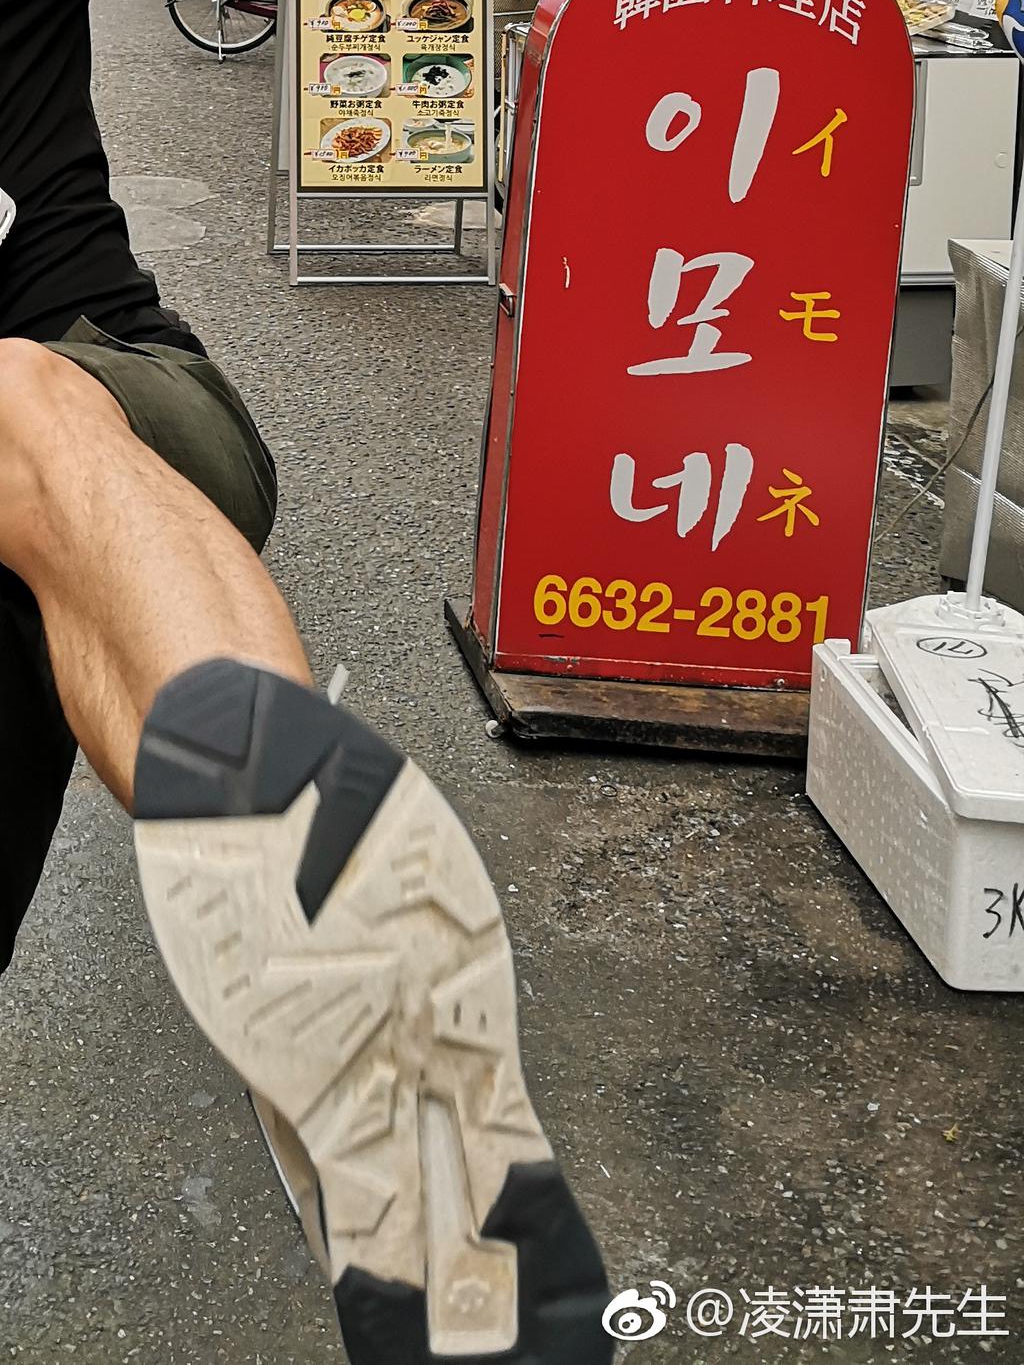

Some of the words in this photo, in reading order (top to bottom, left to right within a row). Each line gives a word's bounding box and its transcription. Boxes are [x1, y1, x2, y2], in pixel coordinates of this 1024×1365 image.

[414, 165, 463, 174] ラーメン定食
[609, 66, 781, 552] 이모네
[756, 107, 848, 539] イモネ
[533, 573, 830, 645] 6632-2881
